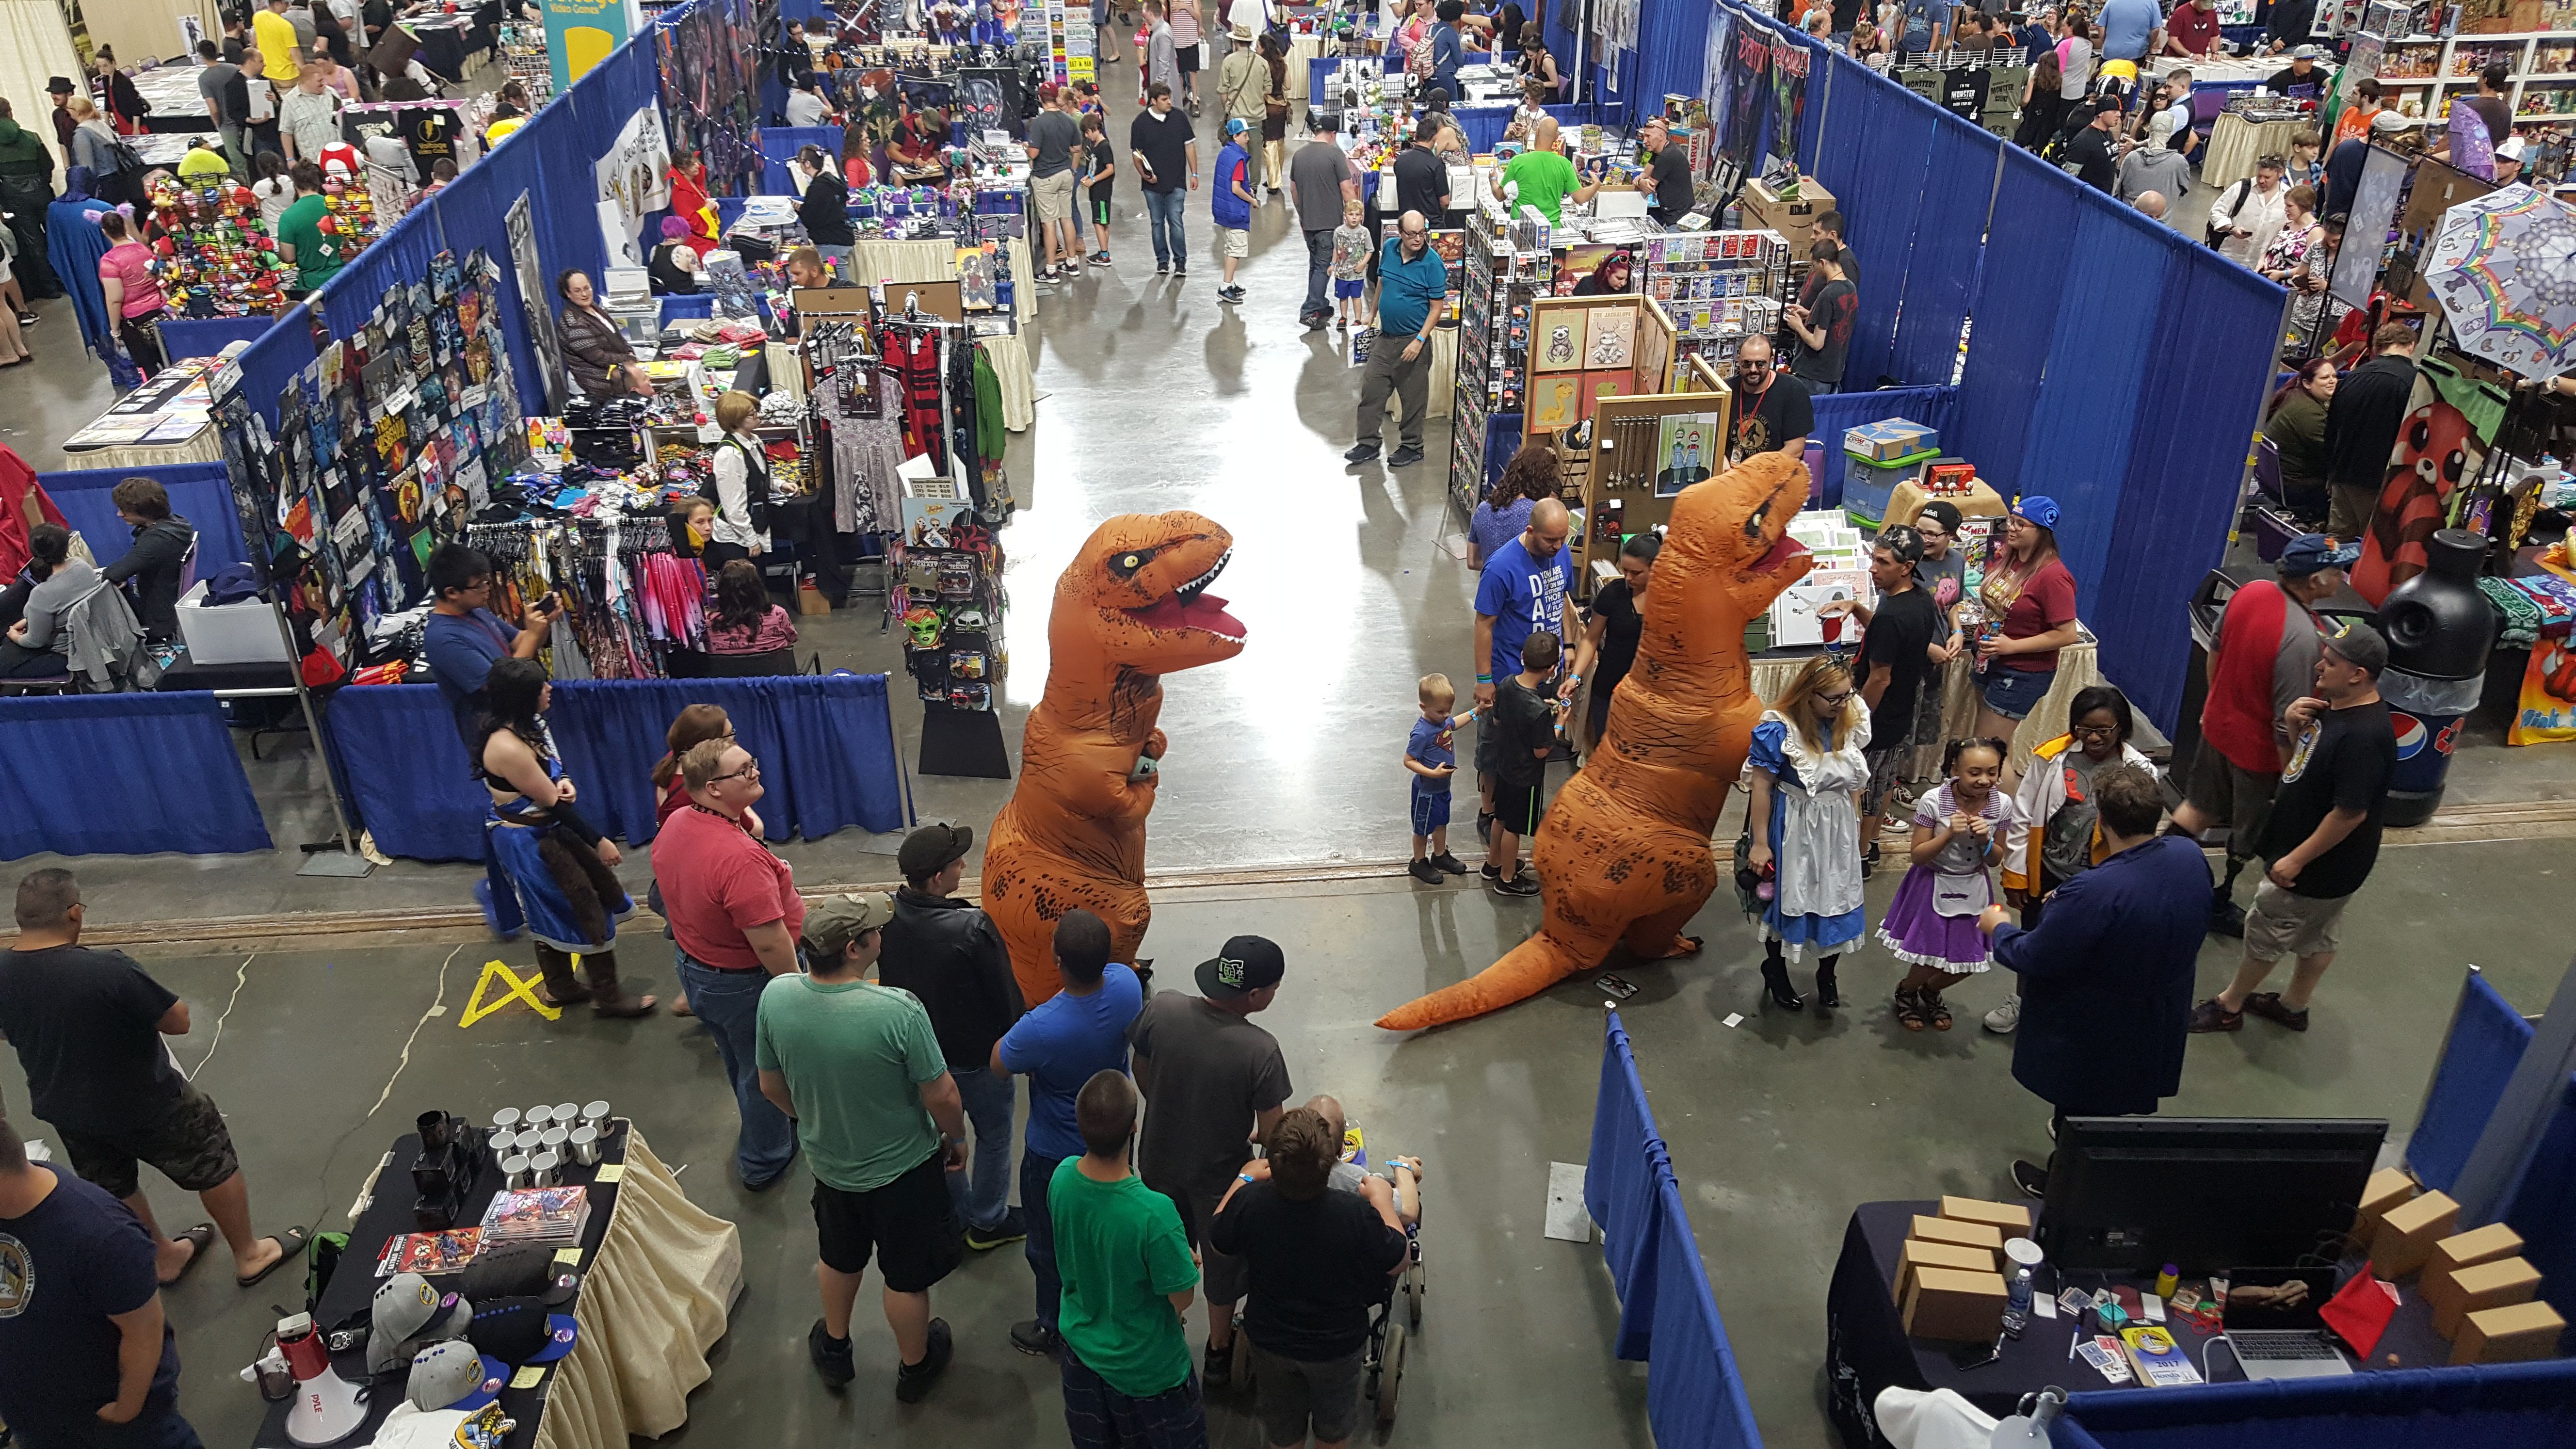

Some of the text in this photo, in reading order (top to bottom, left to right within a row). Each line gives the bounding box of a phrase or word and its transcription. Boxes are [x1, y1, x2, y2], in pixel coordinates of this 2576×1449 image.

[549, 3, 571, 13] Video
[573, 4, 600, 14] Games
[1905, 80, 1937, 89] MONSTERS
[1991, 84, 2015, 95] MONSTER
[1951, 89, 1976, 99] MONSTER
[1847, 435, 1865, 444] ZOOM
[1540, 564, 1562, 580] YOU ARE
[1547, 574, 1559, 582] SMART
[1548, 586, 1562, 595] STRONG
[1545, 592, 1561, 603] THOR
[1553, 602, 1563, 611] FLAS
[1345, 1145, 1354, 1153] CITY
[387, 1253, 399, 1271] BATMAN
[310, 1393, 323, 1414] PYLE
